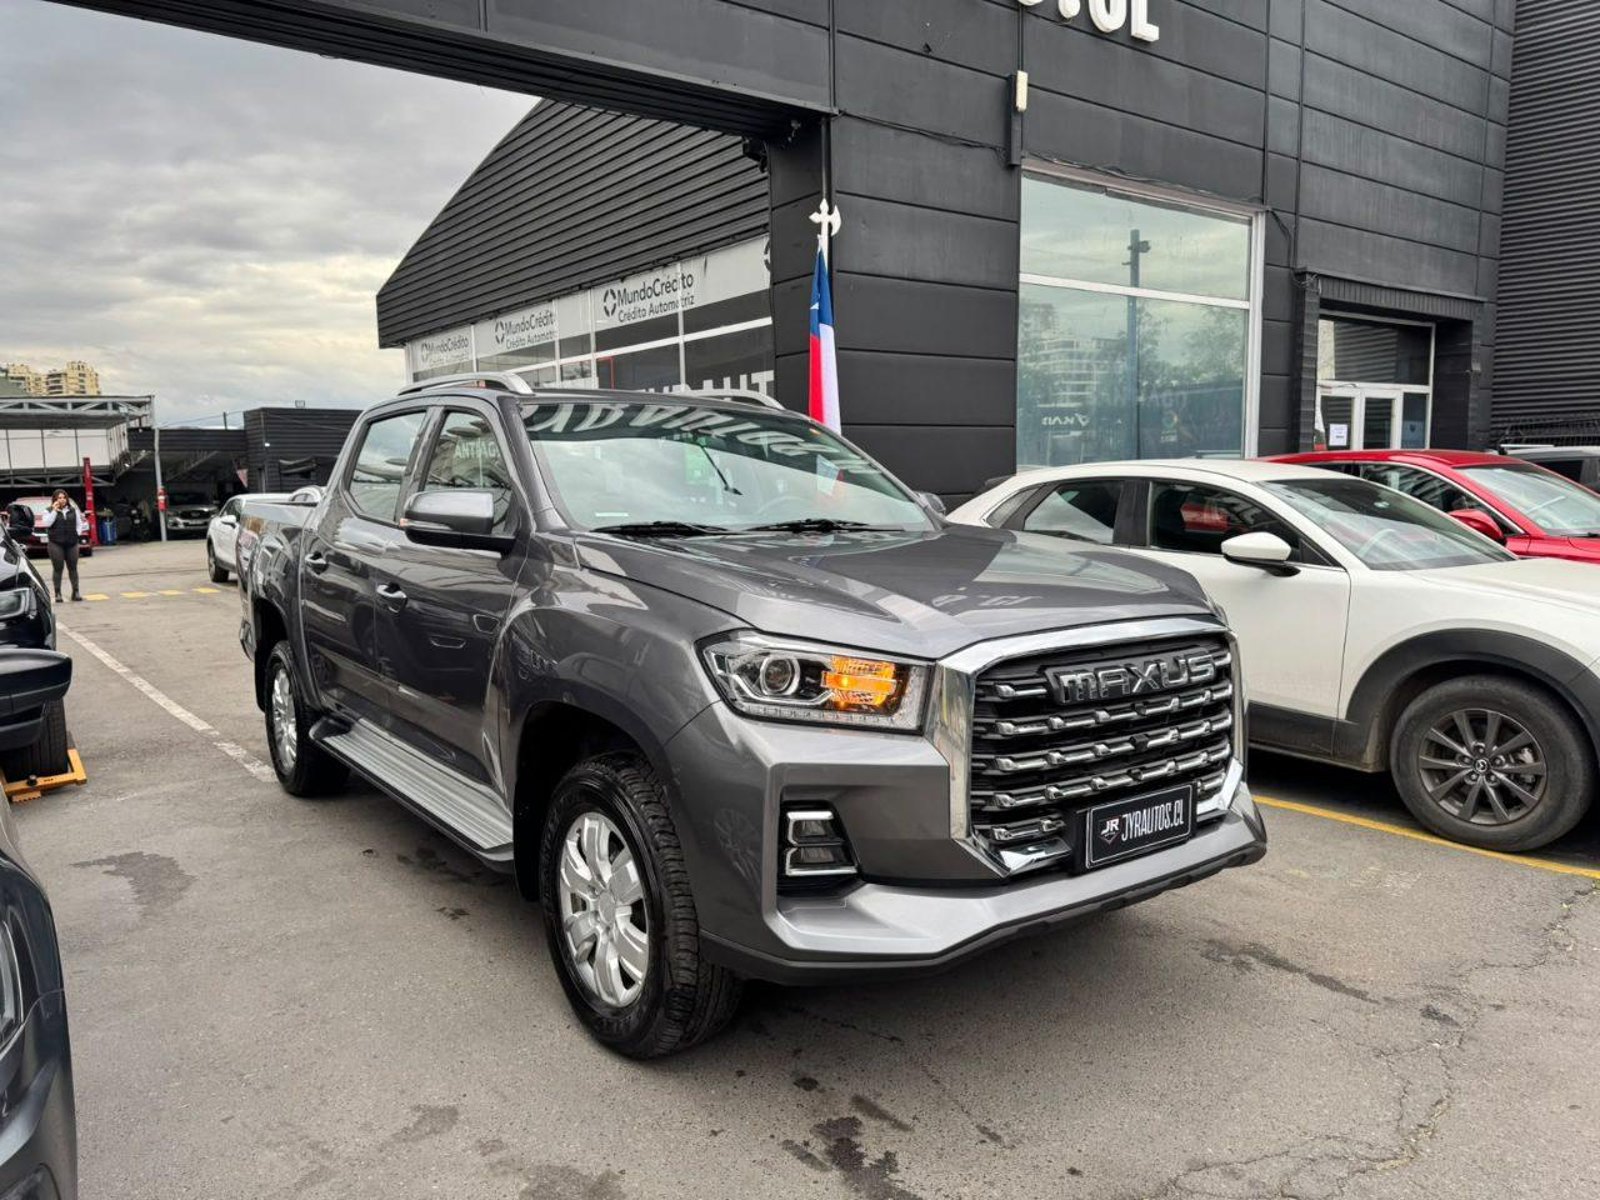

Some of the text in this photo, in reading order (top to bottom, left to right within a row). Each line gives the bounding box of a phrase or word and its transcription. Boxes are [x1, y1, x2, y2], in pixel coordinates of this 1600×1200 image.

[617, 272, 694, 307] MundoCrédto
[504, 309, 555, 336] MundoCrédit
[618, 307, 647, 322] Crédito
[1056, 654, 1216, 703] MAXUS
[1101, 799, 1185, 842] JR JYRAUTOS.CL
